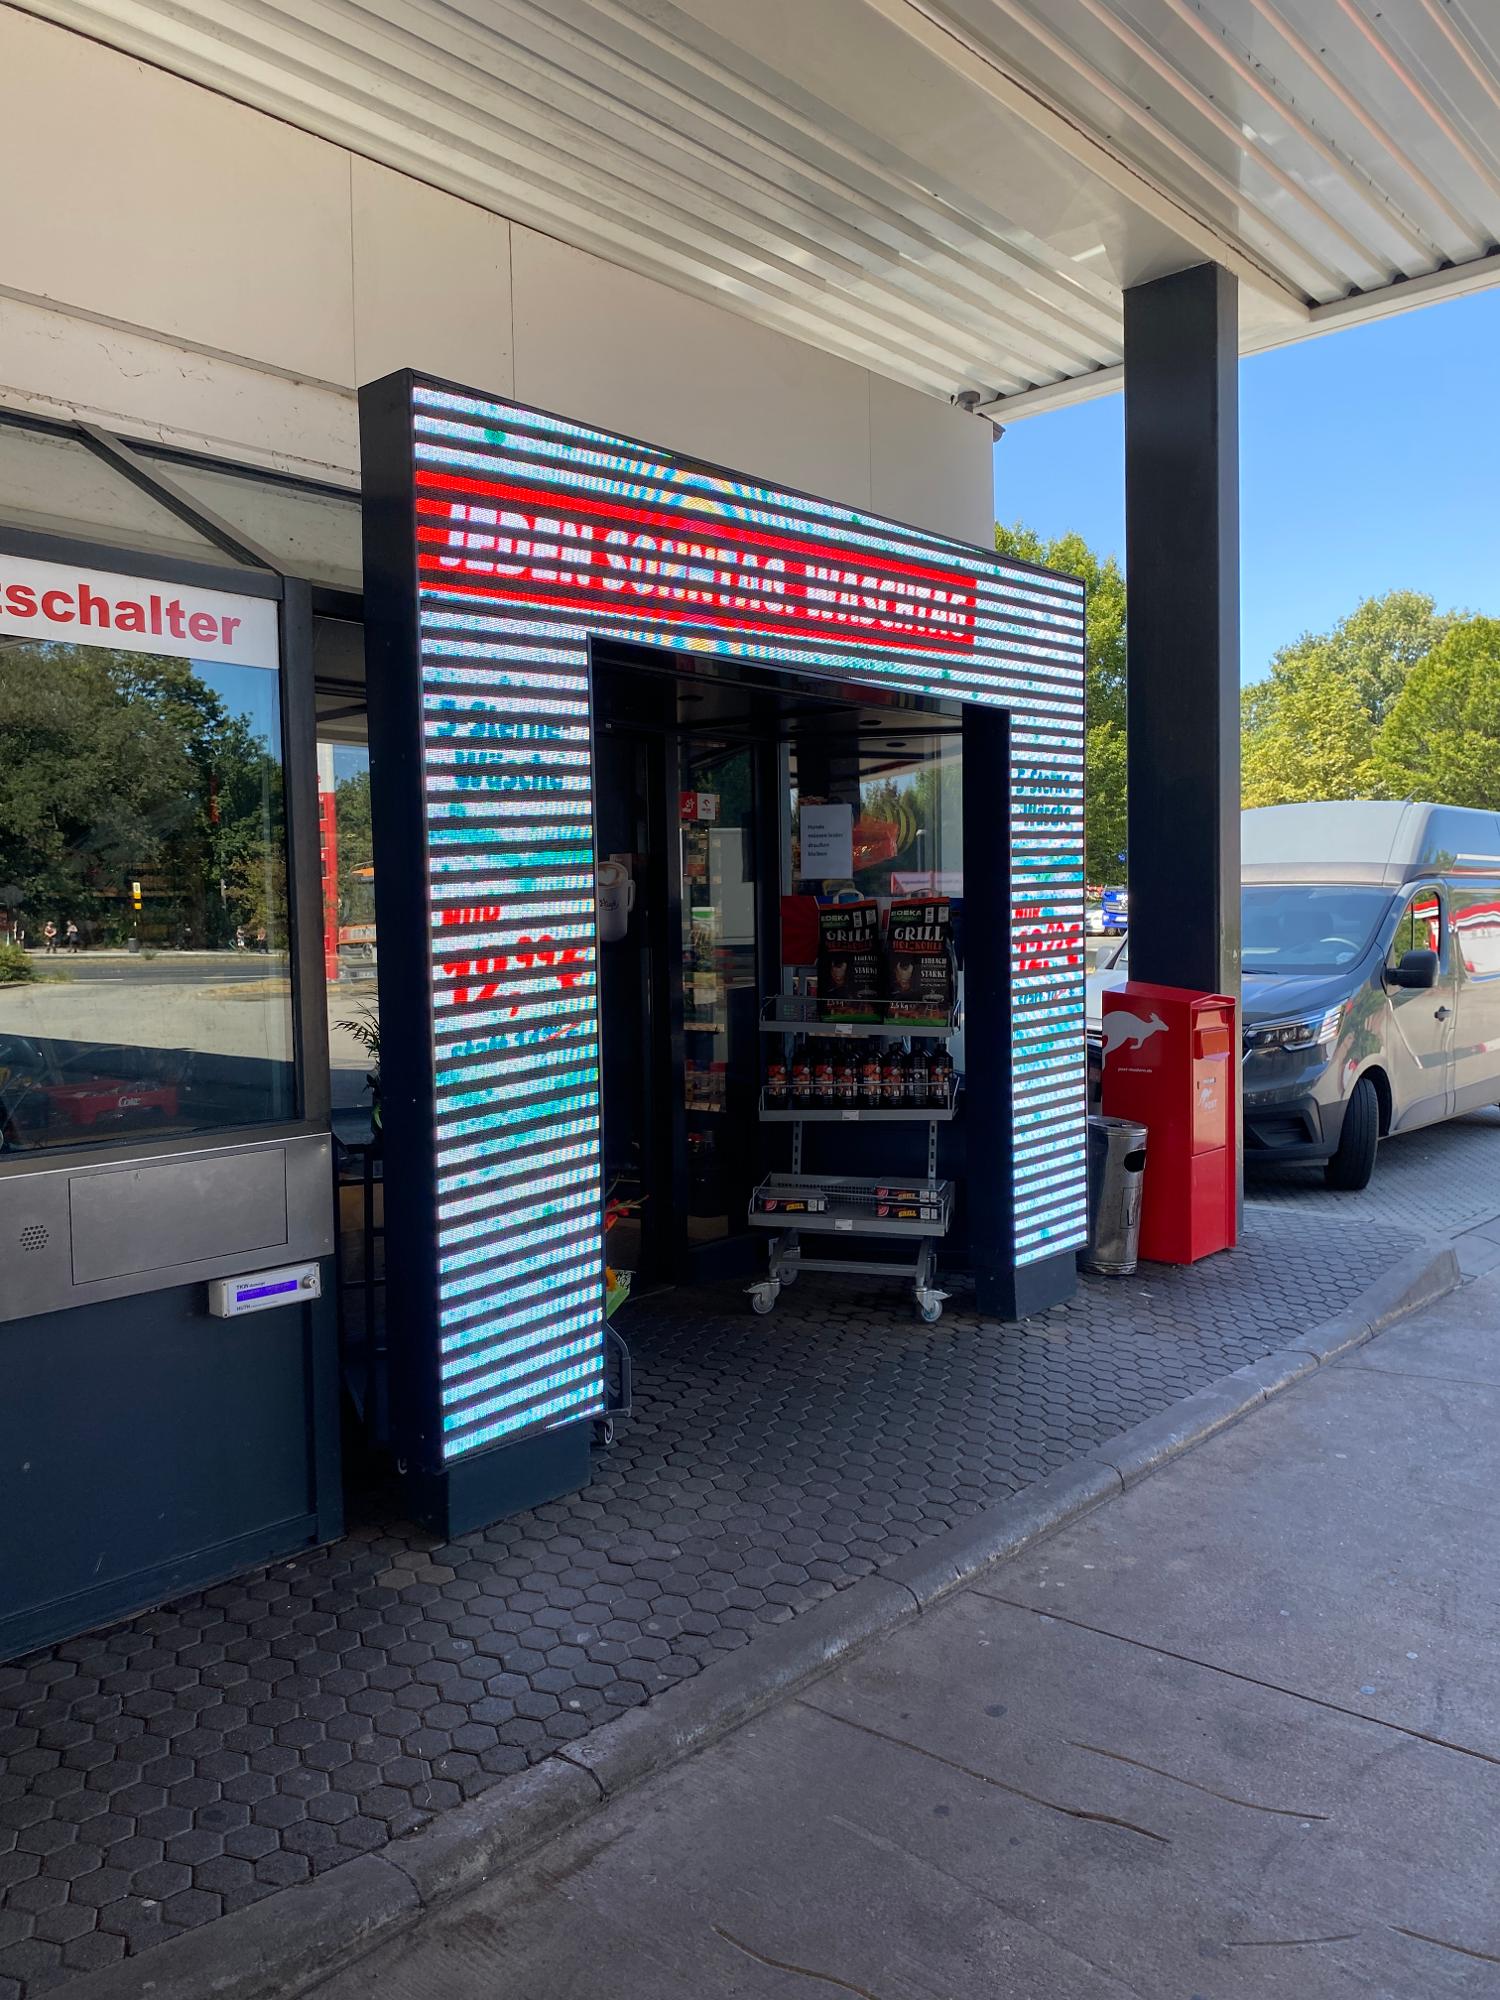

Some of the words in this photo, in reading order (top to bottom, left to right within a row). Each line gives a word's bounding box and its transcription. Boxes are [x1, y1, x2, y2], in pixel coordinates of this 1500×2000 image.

[0, 584, 242, 646] schalter
[825, 928, 874, 943] GRILL
[893, 926, 944, 942] GRILL
